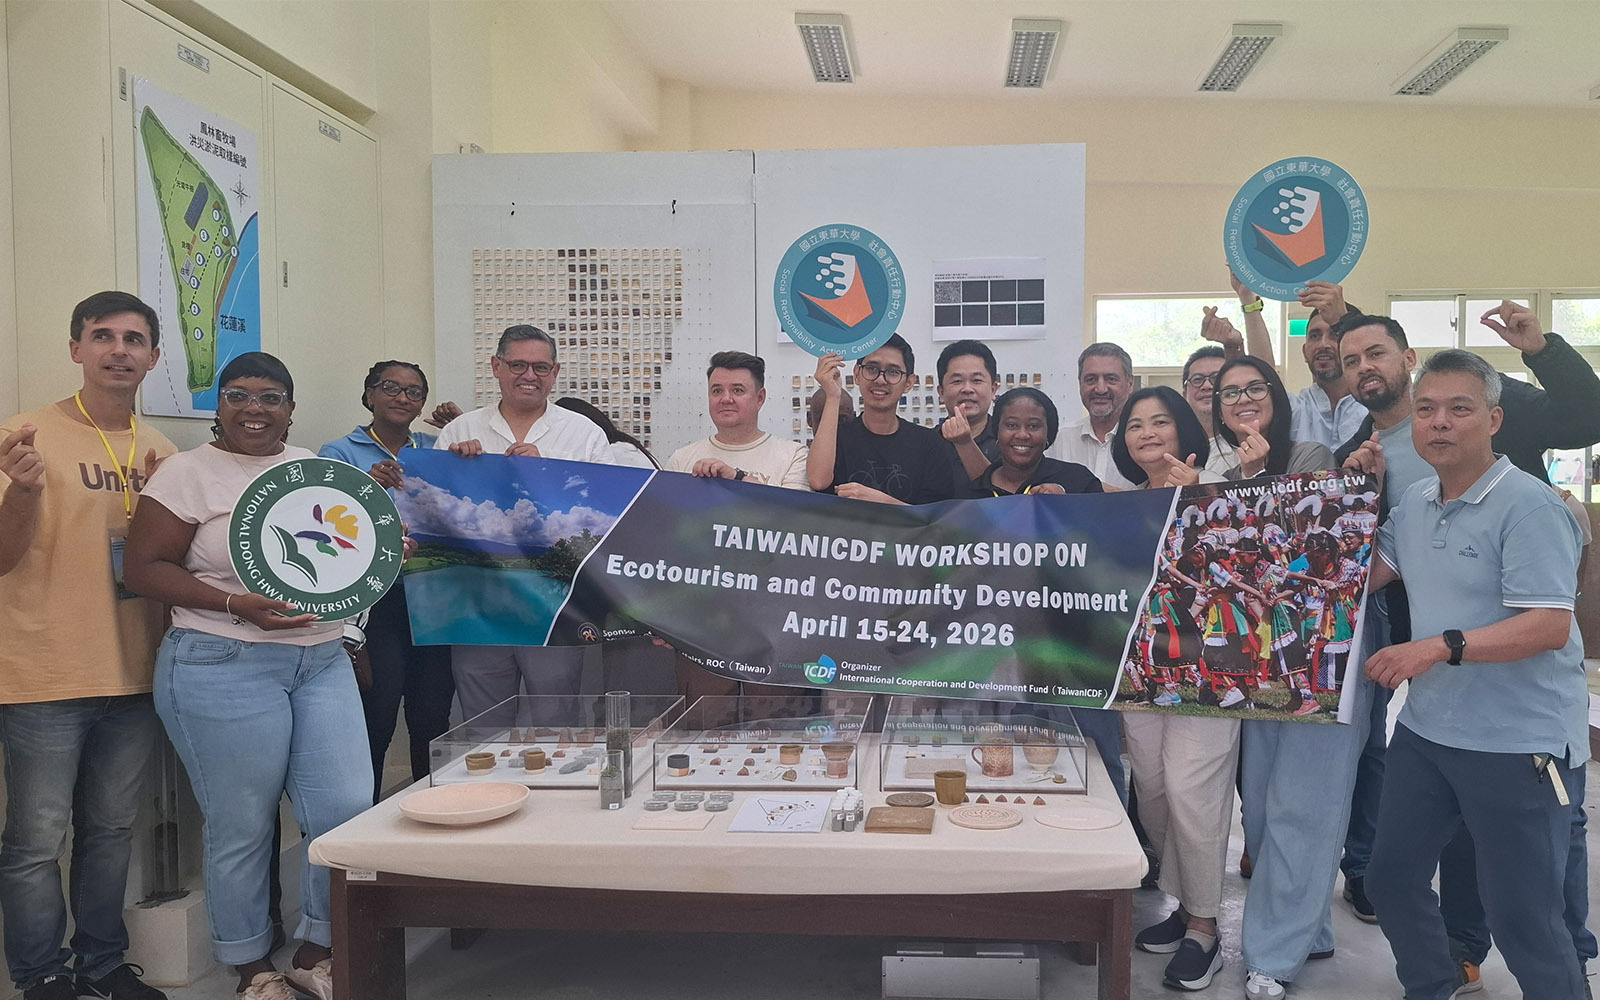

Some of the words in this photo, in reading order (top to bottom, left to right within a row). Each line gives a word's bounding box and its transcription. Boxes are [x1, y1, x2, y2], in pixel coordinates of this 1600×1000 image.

[1263, 161, 1332, 183] 國立東華大學
[1231, 197, 1248, 224] Social
[1336, 177, 1364, 265] 社會責任行動中心
[798, 228, 861, 252] 國立東華大學
[1229, 228, 1256, 284] Responsibility
[780, 268, 791, 294] Social
[868, 239, 902, 320] 社會責任行動中心
[1259, 281, 1288, 296] Action
[220, 313, 247, 334] 花蓮溪
[780, 299, 816, 349] Responsibility
[819, 345, 847, 355] Action
[851, 336, 878, 354] Center
[1224, 474, 1366, 499] www.icdf.org.tw
[238, 480, 278, 538] NATIONAL
[712, 523, 886, 564] TAIWANICDF
[895, 541, 1049, 567] WORKSHOP
[1054, 542, 1088, 567] ON
[239, 542, 262, 580] DONG
[256, 578, 284, 601] HWA
[606, 553, 758, 591] Ecotourism
[766, 575, 816, 597] and
[824, 576, 967, 611] Community
[976, 584, 1128, 614] Development
[602, 628, 636, 638] Sponsor
[782, 610, 848, 639] April
[855, 617, 937, 648] 15-24,
[946, 621, 1015, 647] 2026
[706, 658, 725, 669] ROC
[804, 664, 837, 680] ICDF
[840, 660, 882, 673] Organizer
[839, 673, 895, 686] International
[896, 677, 949, 688] Cooperation
[949, 680, 967, 689] and
[968, 681, 1027, 693] Development
[1029, 684, 1049, 694] Fund
